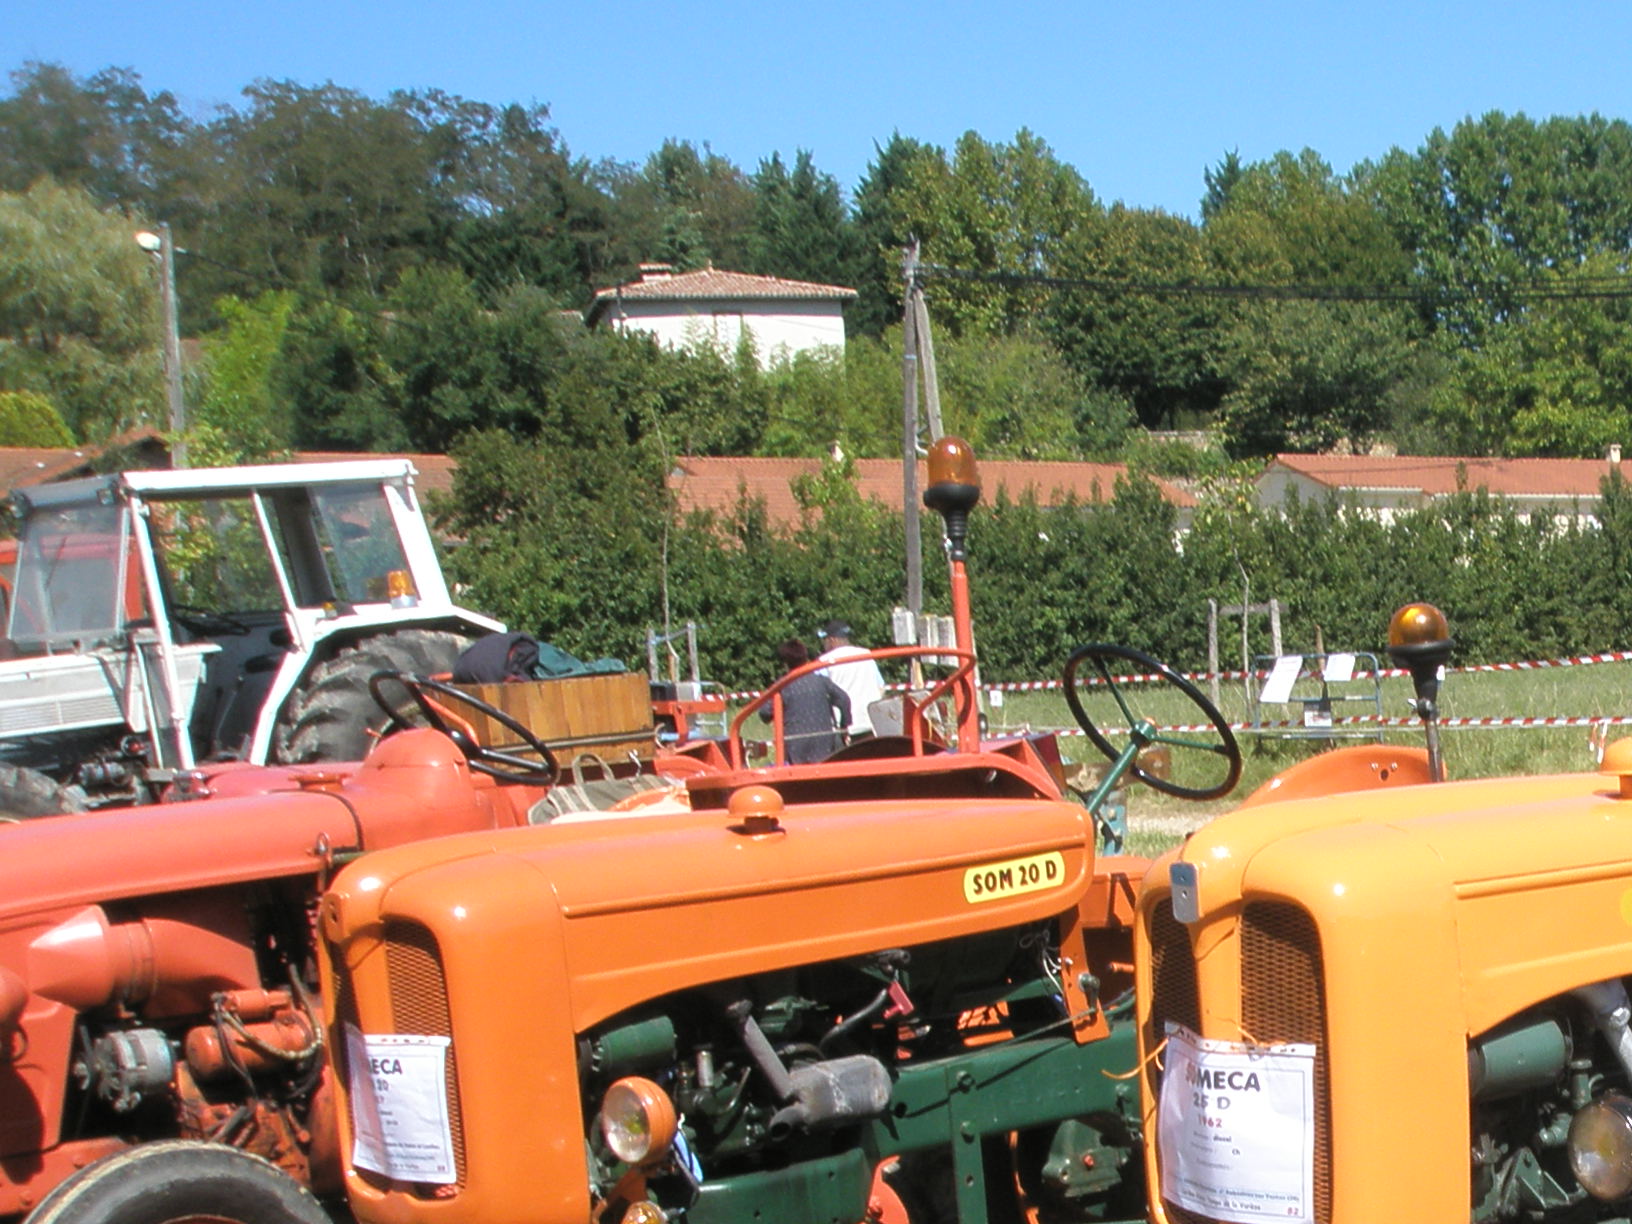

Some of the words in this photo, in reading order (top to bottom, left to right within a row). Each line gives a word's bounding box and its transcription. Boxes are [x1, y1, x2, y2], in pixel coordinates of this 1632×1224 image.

[973, 868, 1013, 895] SOM
[1018, 863, 1040, 886] 20
[1045, 860, 1057, 880] D
[1217, 1096, 1231, 1110] D
